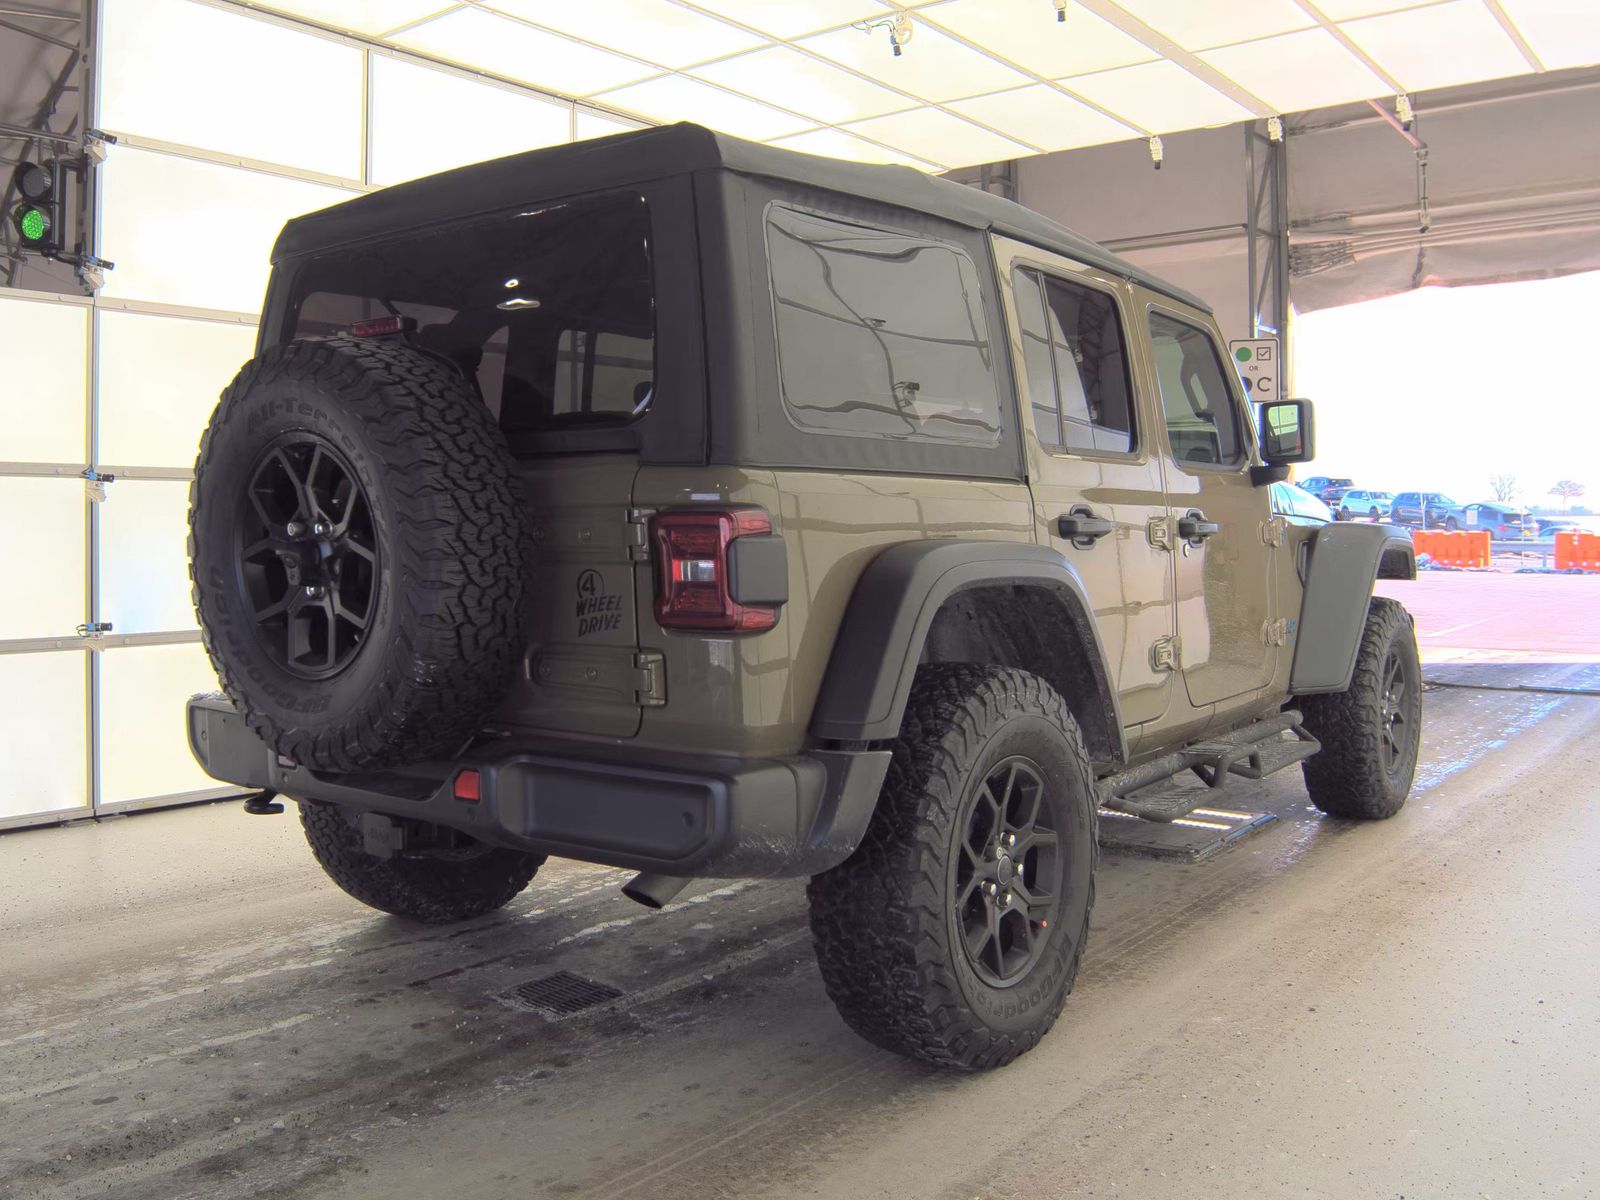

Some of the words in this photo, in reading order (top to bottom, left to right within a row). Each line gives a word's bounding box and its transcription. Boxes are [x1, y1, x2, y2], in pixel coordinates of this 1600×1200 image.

[1248, 364, 1259, 372] OR
[576, 594, 623, 618] WHEEL
[578, 613, 624, 638] DRIVE
